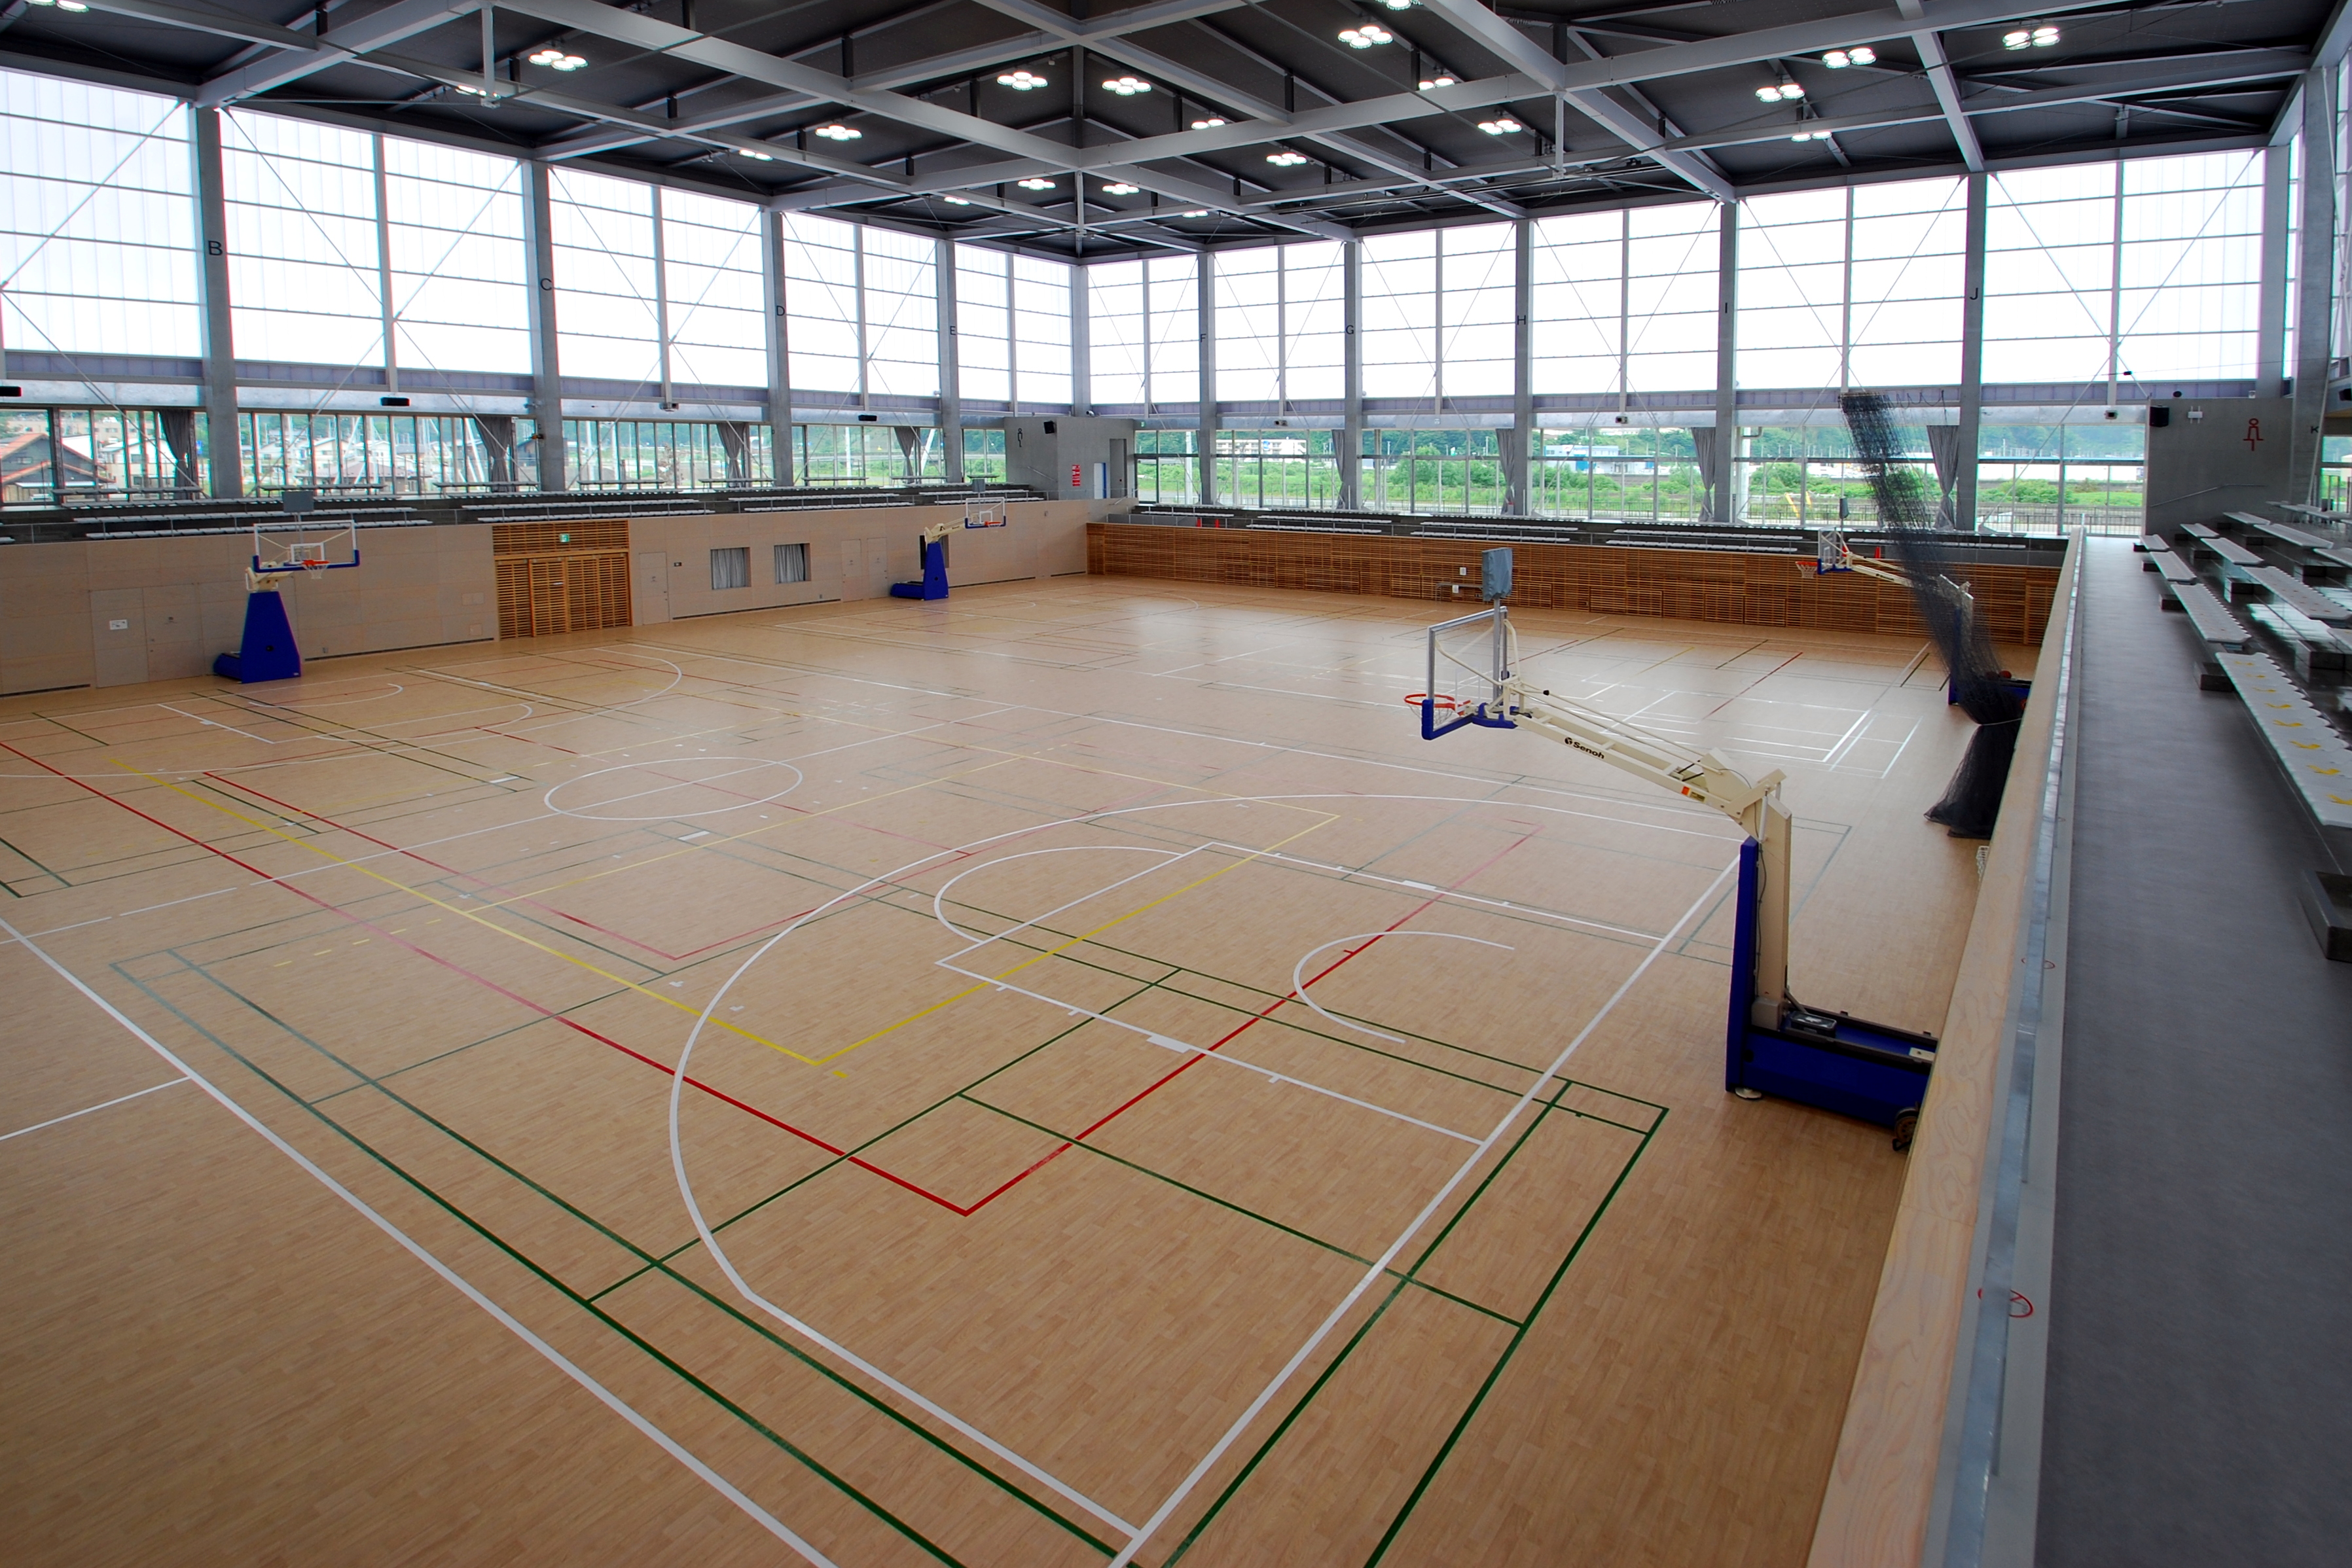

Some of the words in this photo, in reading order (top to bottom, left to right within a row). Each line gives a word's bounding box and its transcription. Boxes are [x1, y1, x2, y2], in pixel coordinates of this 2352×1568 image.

[208, 240, 223, 256] B
[540, 278, 552, 291] C
[1969, 287, 1978, 300] J
[776, 305, 786, 316] D
[1517, 315, 1527, 325] H
[950, 325, 956, 335] E
[1346, 325, 1354, 334] G
[1200, 333, 1206, 342] F
[1573, 741, 1604, 759] Senoh
